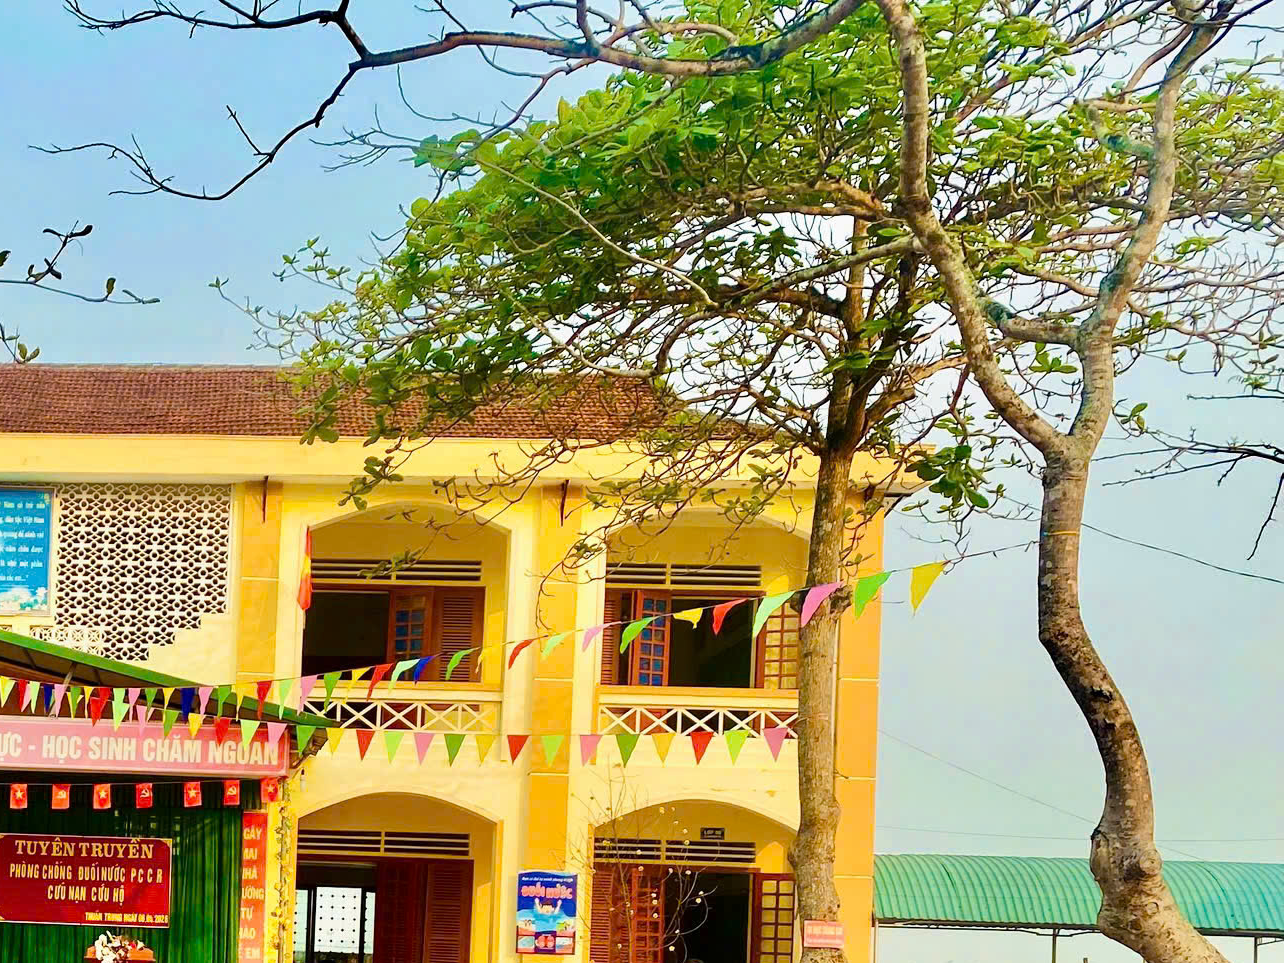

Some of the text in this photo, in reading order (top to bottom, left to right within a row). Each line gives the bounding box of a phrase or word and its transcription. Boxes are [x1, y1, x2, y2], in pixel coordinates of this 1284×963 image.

[42, 735, 82, 764] HỌC
[88, 736, 137, 761] SINH
[143, 733, 202, 764] CHĂM
[208, 740, 279, 765] NGOAN
[244, 824, 263, 840] GÀY
[15, 837, 154, 859] TUYÊN TRUYỀN
[9, 862, 39, 879] PHÒNG
[42, 861, 73, 880] CHỐNG
[78, 862, 100, 881] ĐUỐI
[101, 863, 126, 883] NƯỚC
[68, 885, 86, 904] NẠN
[91, 883, 110, 902] CỨU
[113, 884, 125, 906] HỘ
